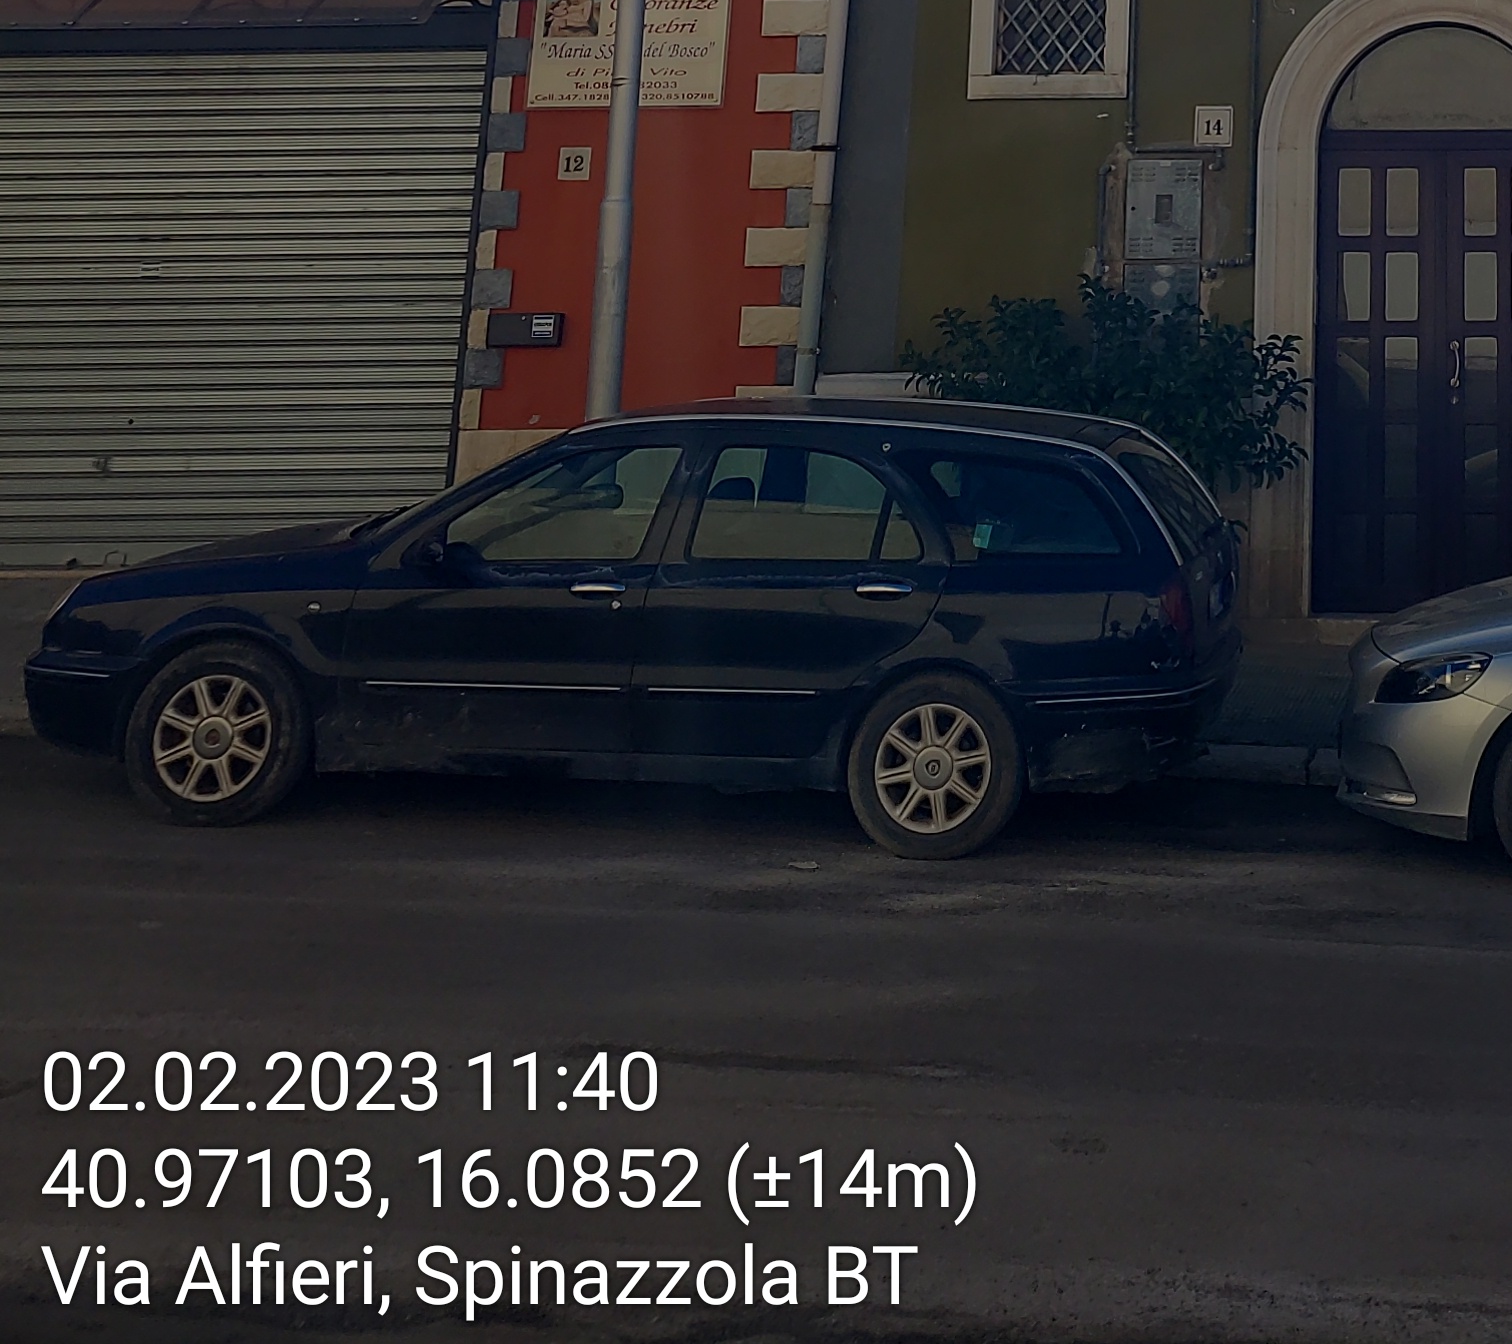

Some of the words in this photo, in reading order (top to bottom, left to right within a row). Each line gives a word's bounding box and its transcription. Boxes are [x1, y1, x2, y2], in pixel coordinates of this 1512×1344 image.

[605, 16, 698, 37] nebri
[643, 41, 667, 58] del
[668, 41, 716, 58] Bosco"
[566, 67, 586, 77] di
[650, 67, 687, 76] Vito
[1204, 119, 1223, 136] 14
[563, 155, 584, 173] 12
